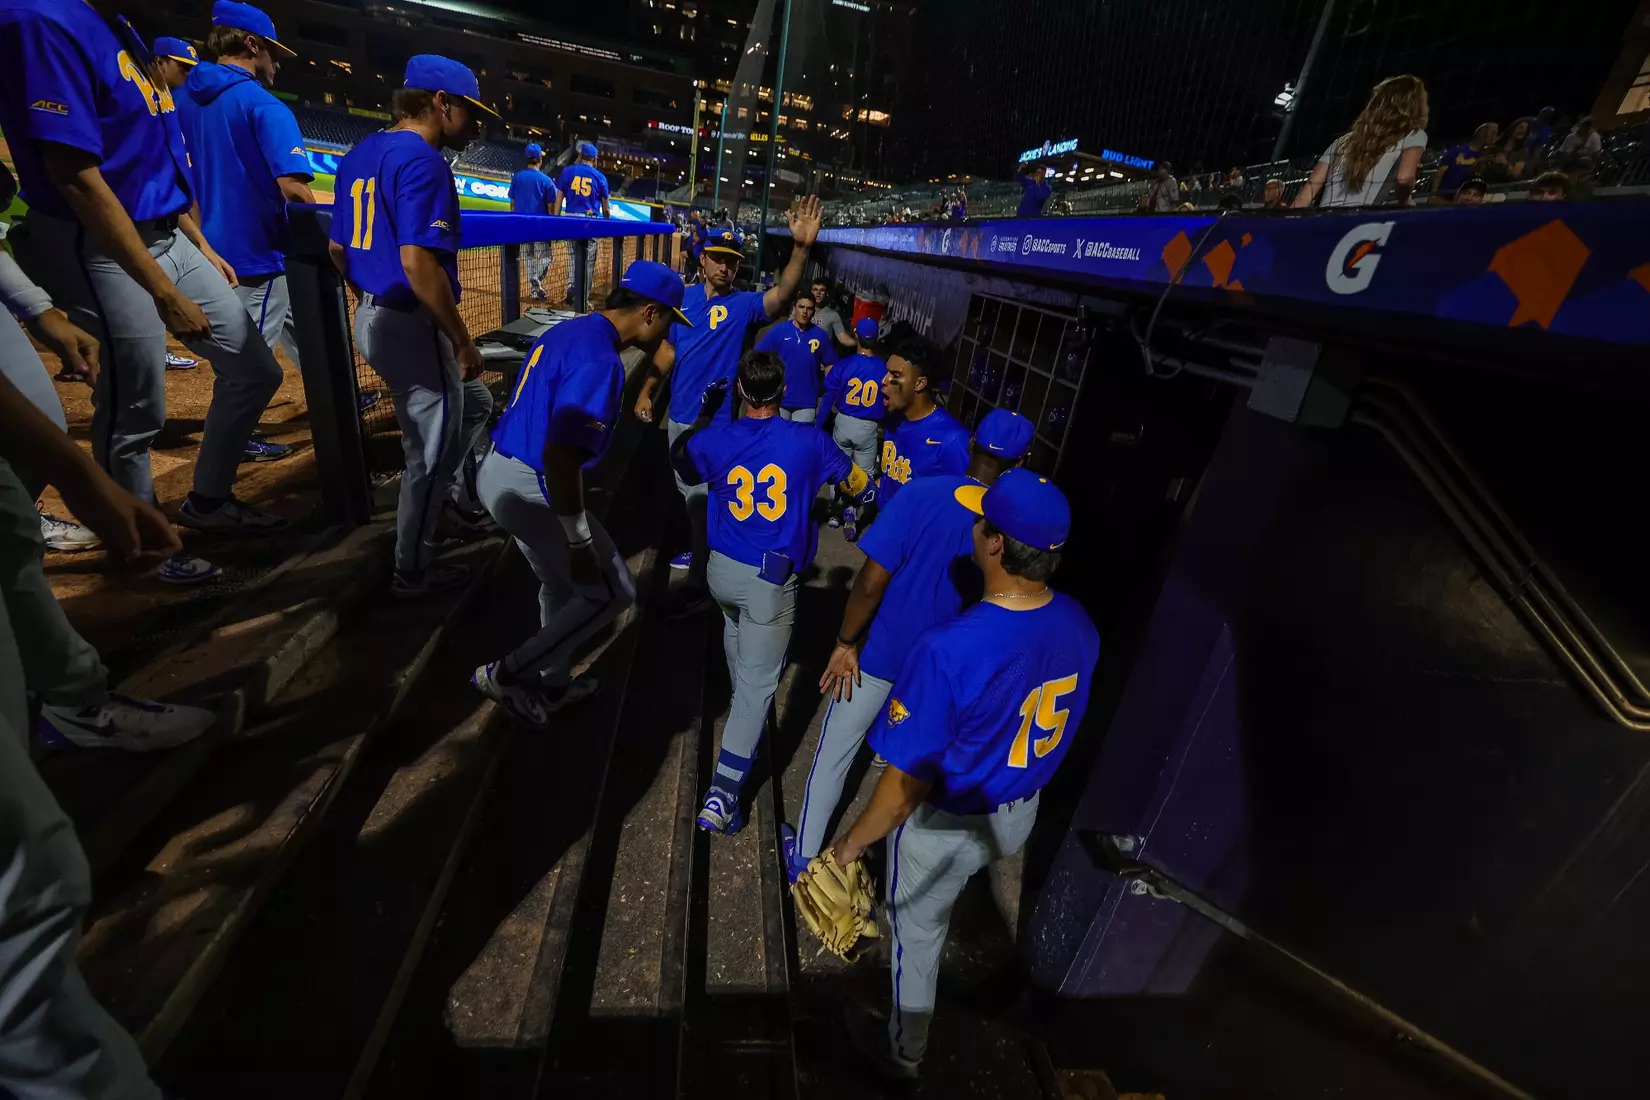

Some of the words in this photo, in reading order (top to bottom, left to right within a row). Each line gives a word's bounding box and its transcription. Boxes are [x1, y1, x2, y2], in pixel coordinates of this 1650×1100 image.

[30, 99, 69, 116] ACC
[1101, 149, 1123, 163] BUD
[570, 175, 593, 197] 45
[350, 177, 376, 250] 11
[1325, 221, 1396, 295] G
[706, 304, 729, 331] P
[808, 338, 821, 354] P
[845, 377, 879, 408] 20
[880, 440, 913, 485] Pitt
[727, 462, 787, 523] 33
[1007, 672, 1079, 769] 15
